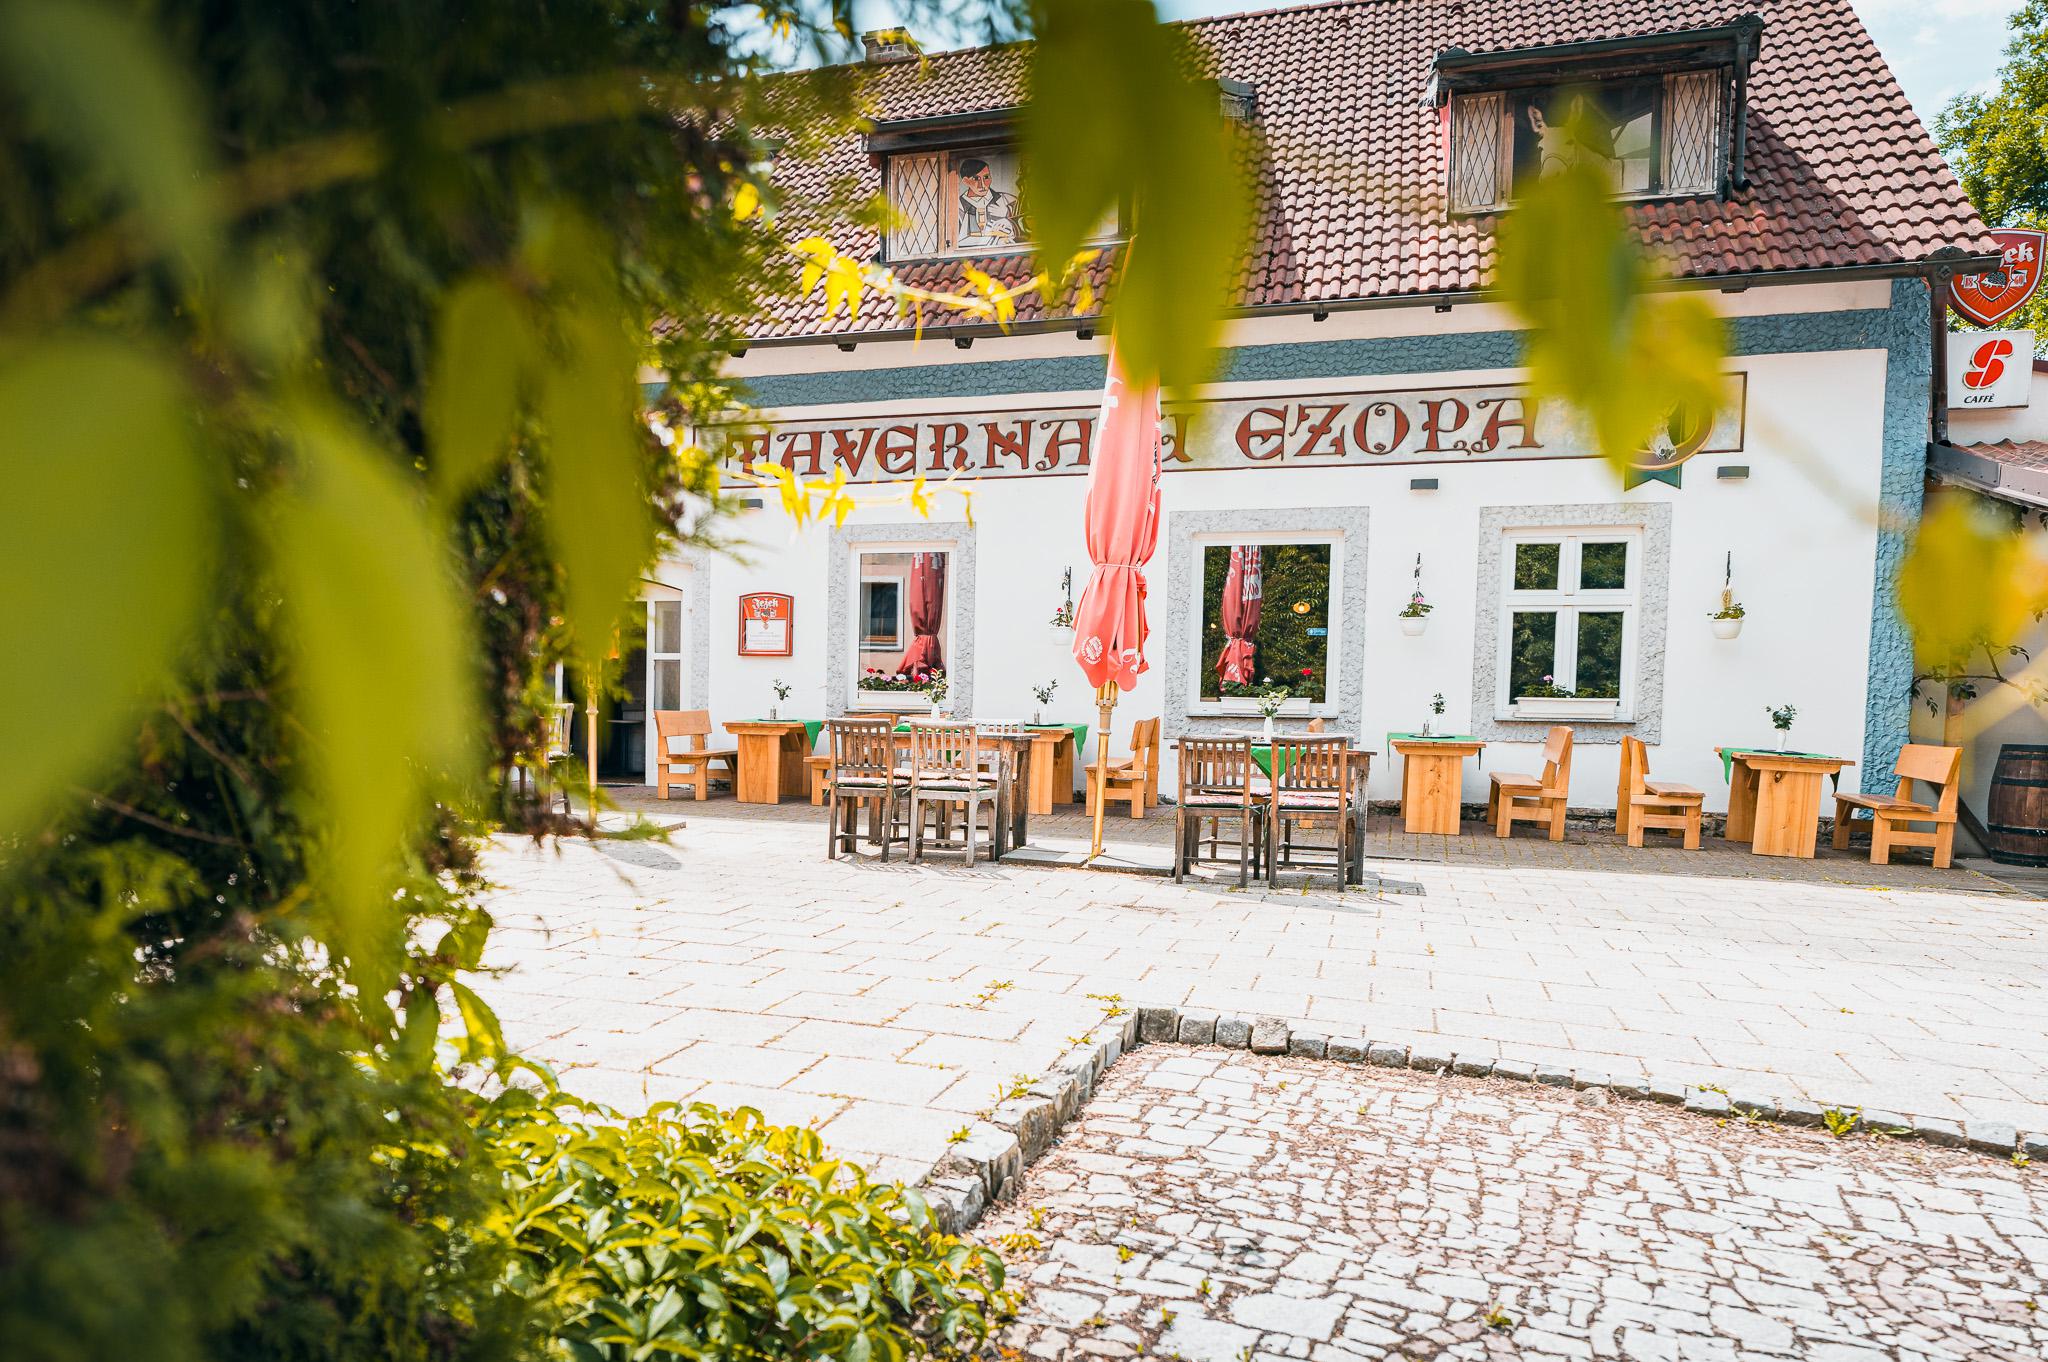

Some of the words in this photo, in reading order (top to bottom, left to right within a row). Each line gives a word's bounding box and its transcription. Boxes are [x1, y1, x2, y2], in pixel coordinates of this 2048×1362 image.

[1963, 393, 1995, 404] CAFFÈ
[725, 416, 1096, 480] TAVERNA
[1234, 397, 1545, 462] EZOPA
